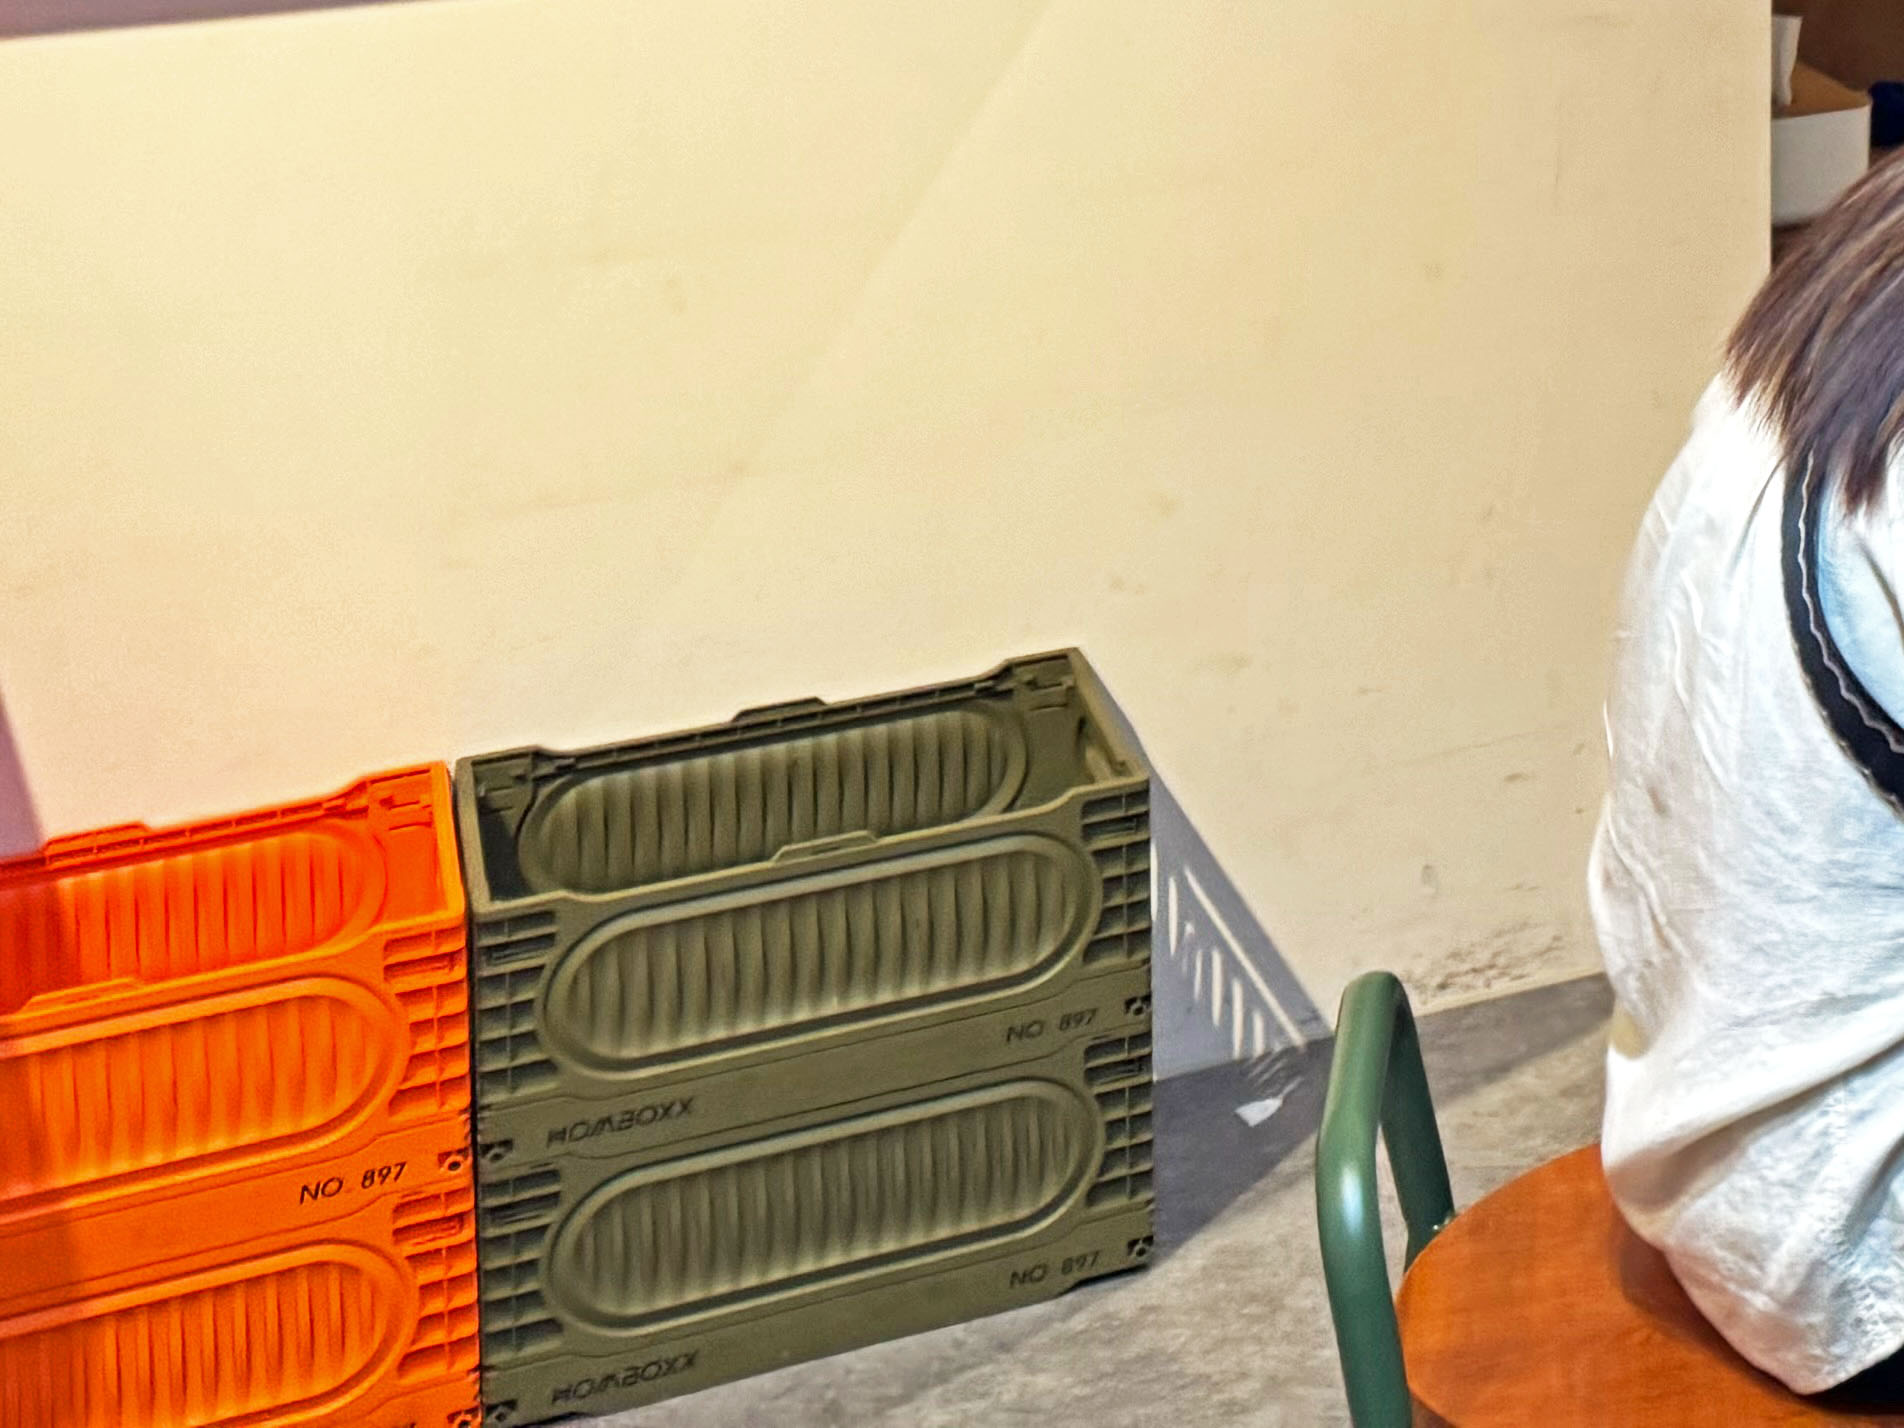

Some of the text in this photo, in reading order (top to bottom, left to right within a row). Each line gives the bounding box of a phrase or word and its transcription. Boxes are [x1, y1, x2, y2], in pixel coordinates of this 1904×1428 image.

[1006, 1007, 1098, 1044] NO 897
[300, 1161, 407, 1205] NO 897
[1009, 1249, 1103, 1288] NO 897
